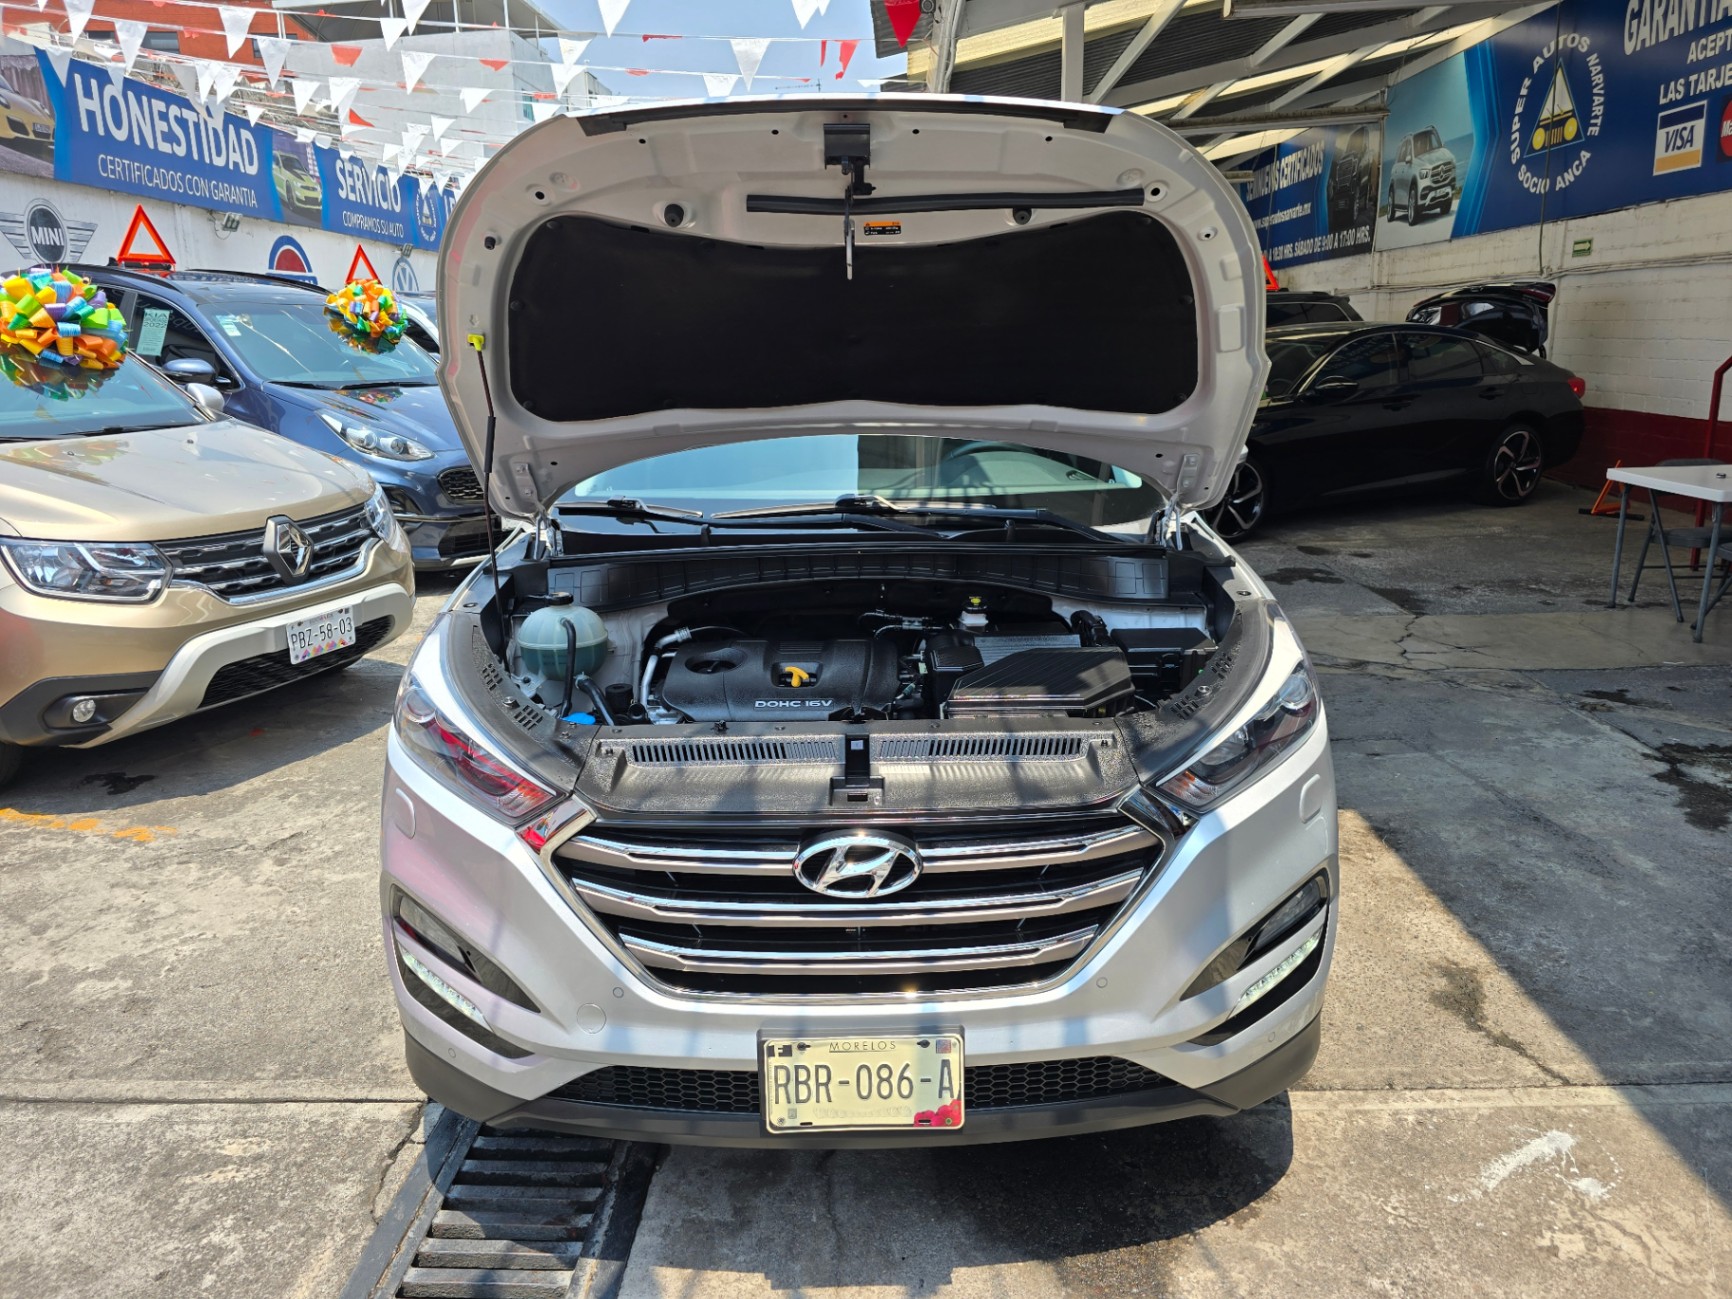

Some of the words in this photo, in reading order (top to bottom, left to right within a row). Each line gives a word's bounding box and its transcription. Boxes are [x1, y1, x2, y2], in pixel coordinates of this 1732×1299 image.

[1510, 77, 1532, 165] SUPER
[1532, 33, 1590, 74] AUTOS
[1586, 53, 1605, 137] NARVARTE
[1659, 78, 1685, 105] LAS
[74, 73, 259, 176] HONESTIDAD
[1664, 125, 1695, 153] VISA
[1280, 140, 1324, 189] CERTIFICADOS
[1518, 164, 1549, 194] SOCIO
[1555, 150, 1592, 191] ANCA
[98, 154, 184, 192] CERTIFICADOS
[186, 174, 209, 198] CON
[210, 180, 258, 208] GARANTIA
[30, 226, 64, 246] MINI
[343, 211, 380, 233] COMPRAMOS
[389, 220, 404, 238] AUTO
[1334, 232, 1339, 249] A
[291, 617, 352, 651] PBZ-58-03
[755, 700, 801, 708] DOHC
[805, 699, 833, 707] 16V
[829, 1041, 896, 1050] MORELOS
[774, 1059, 954, 1104] RBR-086-A
